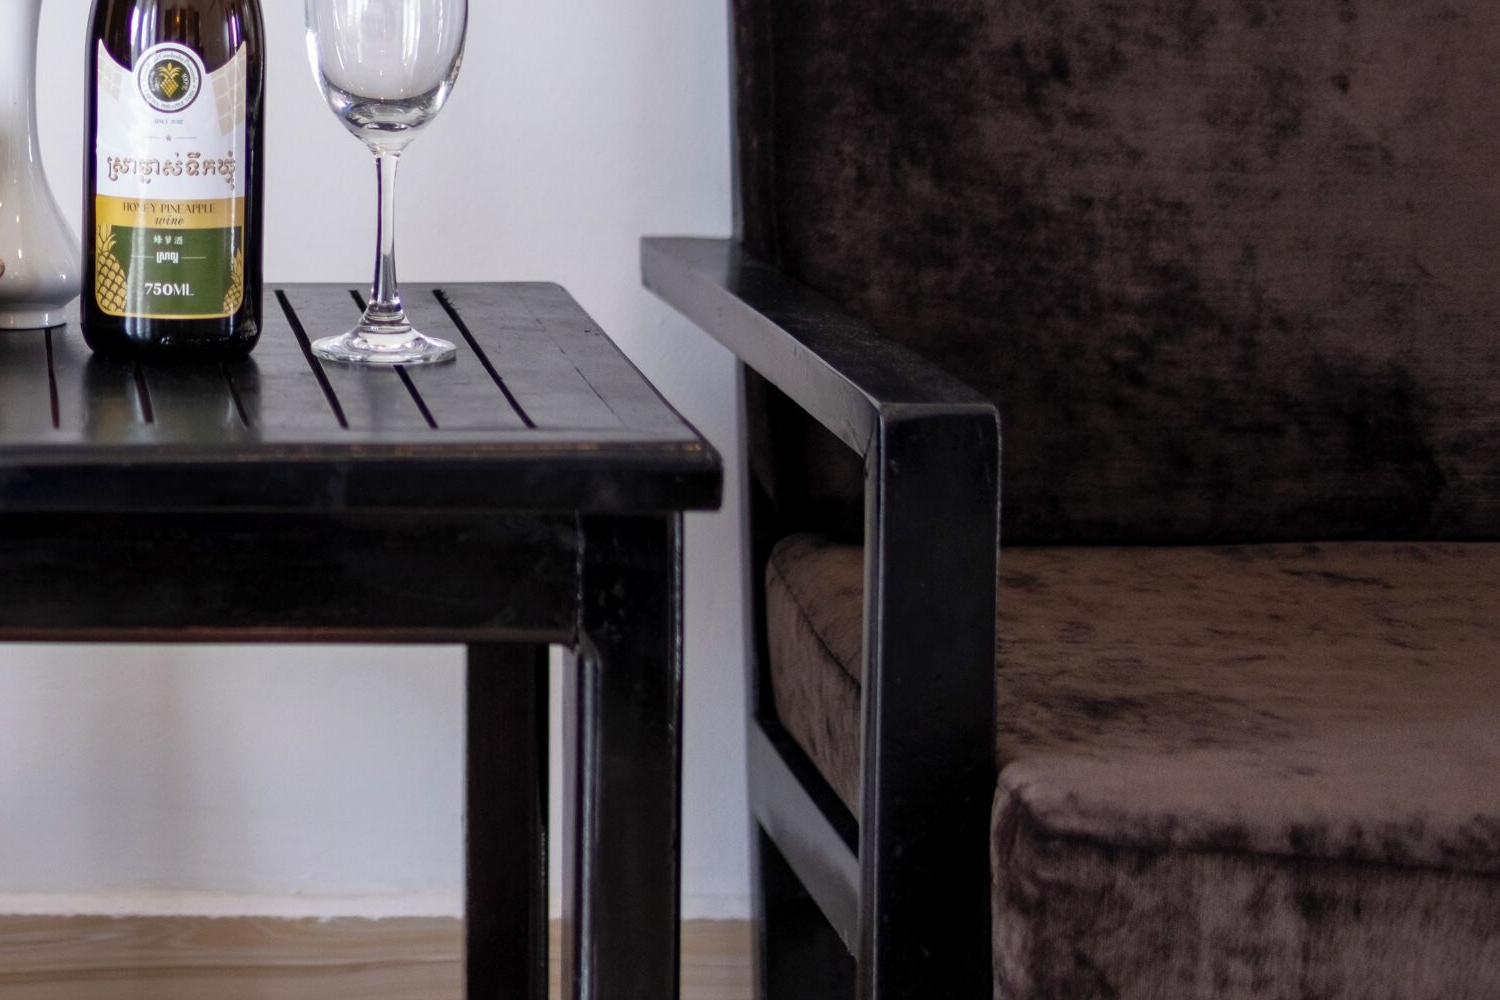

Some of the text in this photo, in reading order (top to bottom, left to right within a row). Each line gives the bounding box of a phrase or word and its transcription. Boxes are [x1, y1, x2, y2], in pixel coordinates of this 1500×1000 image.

[123, 202, 156, 213] HONEY
[155, 215, 184, 226] wine
[144, 282, 195, 296] 750ML
